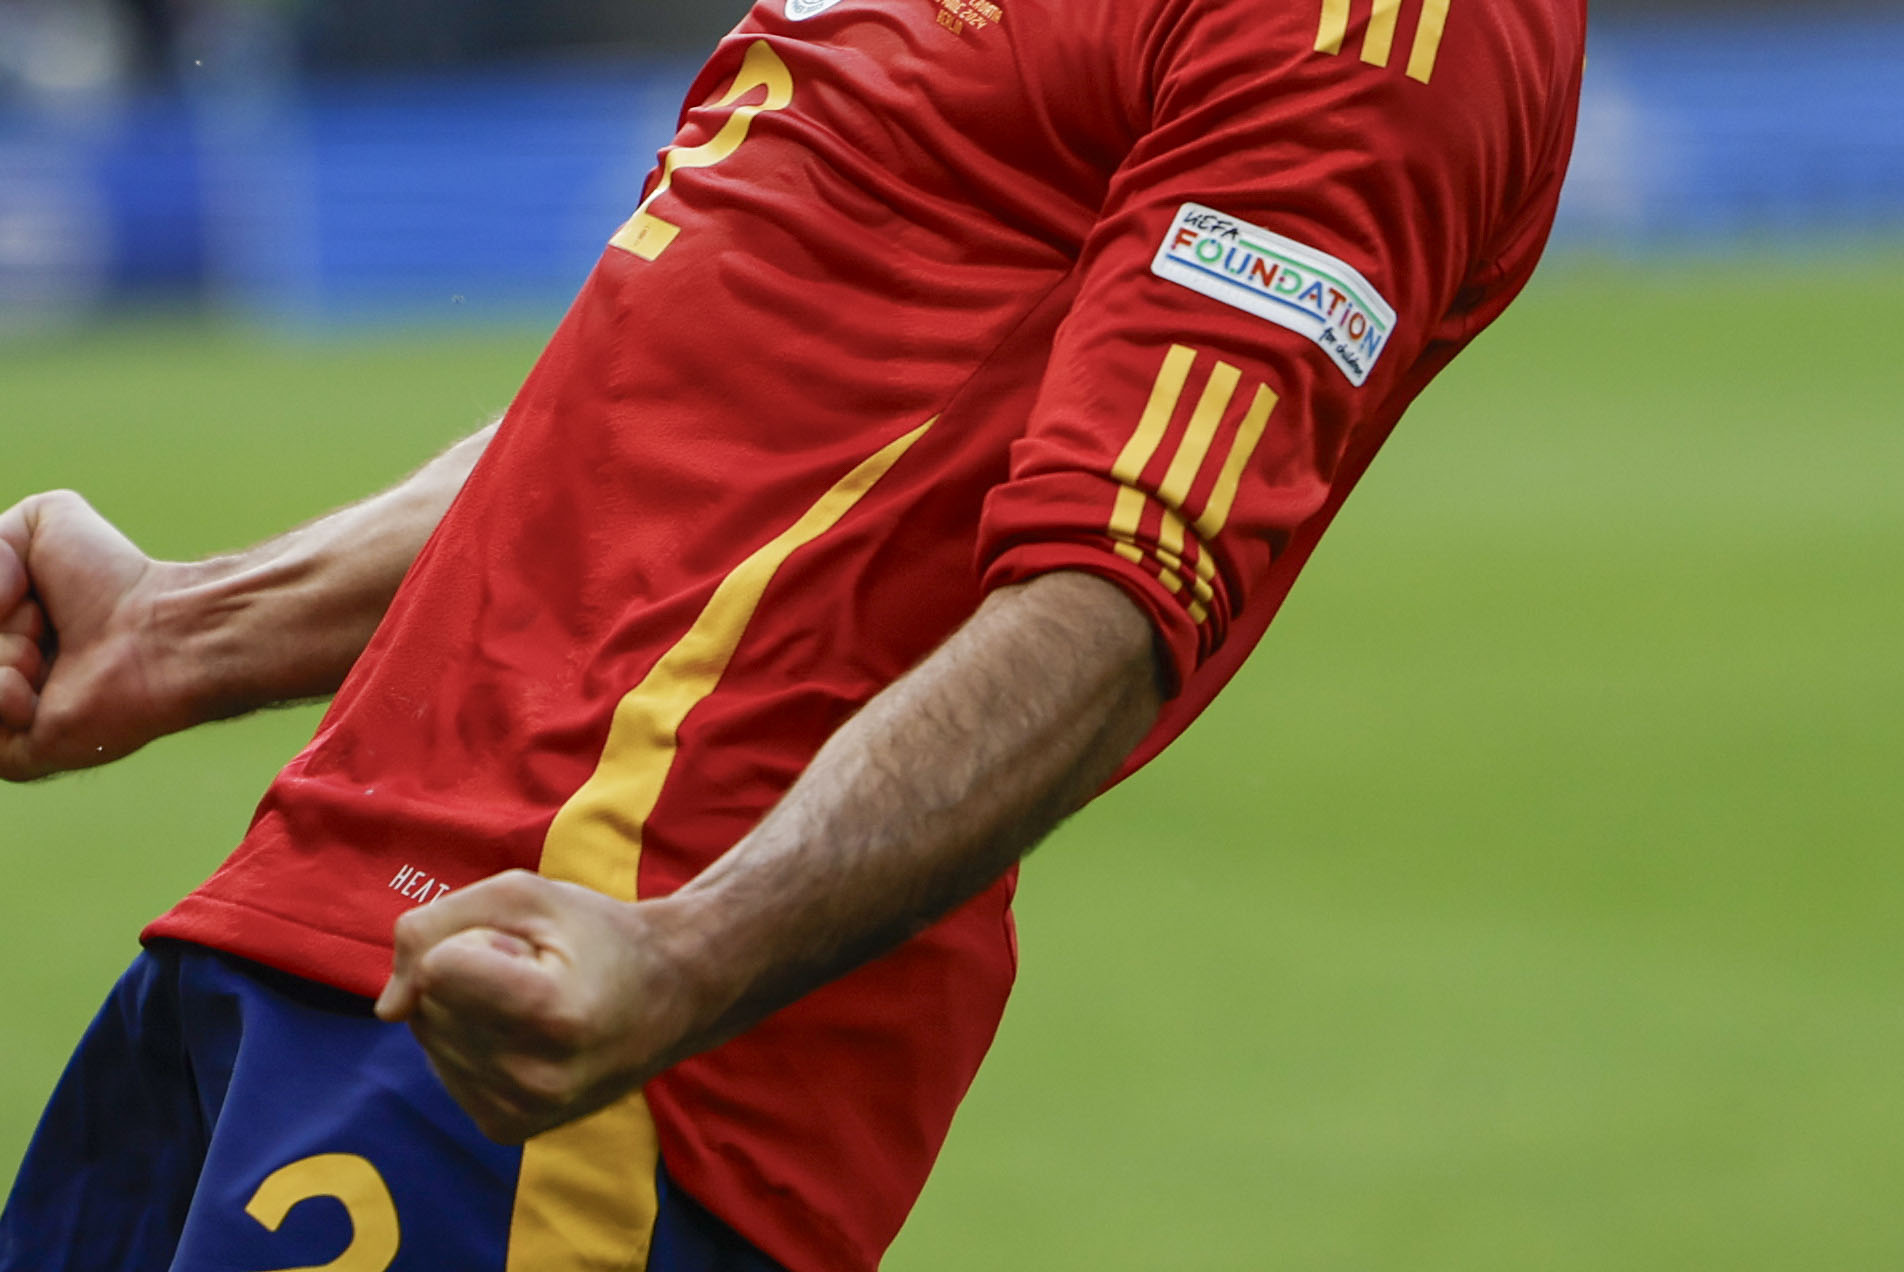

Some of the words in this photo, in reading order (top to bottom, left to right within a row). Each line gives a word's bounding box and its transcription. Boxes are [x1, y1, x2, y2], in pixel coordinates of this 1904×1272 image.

[607, 38, 794, 263] 2
[1183, 211, 1240, 241] UEFA
[387, 863, 451, 906] HEAT
[243, 1152, 401, 1272] 2
